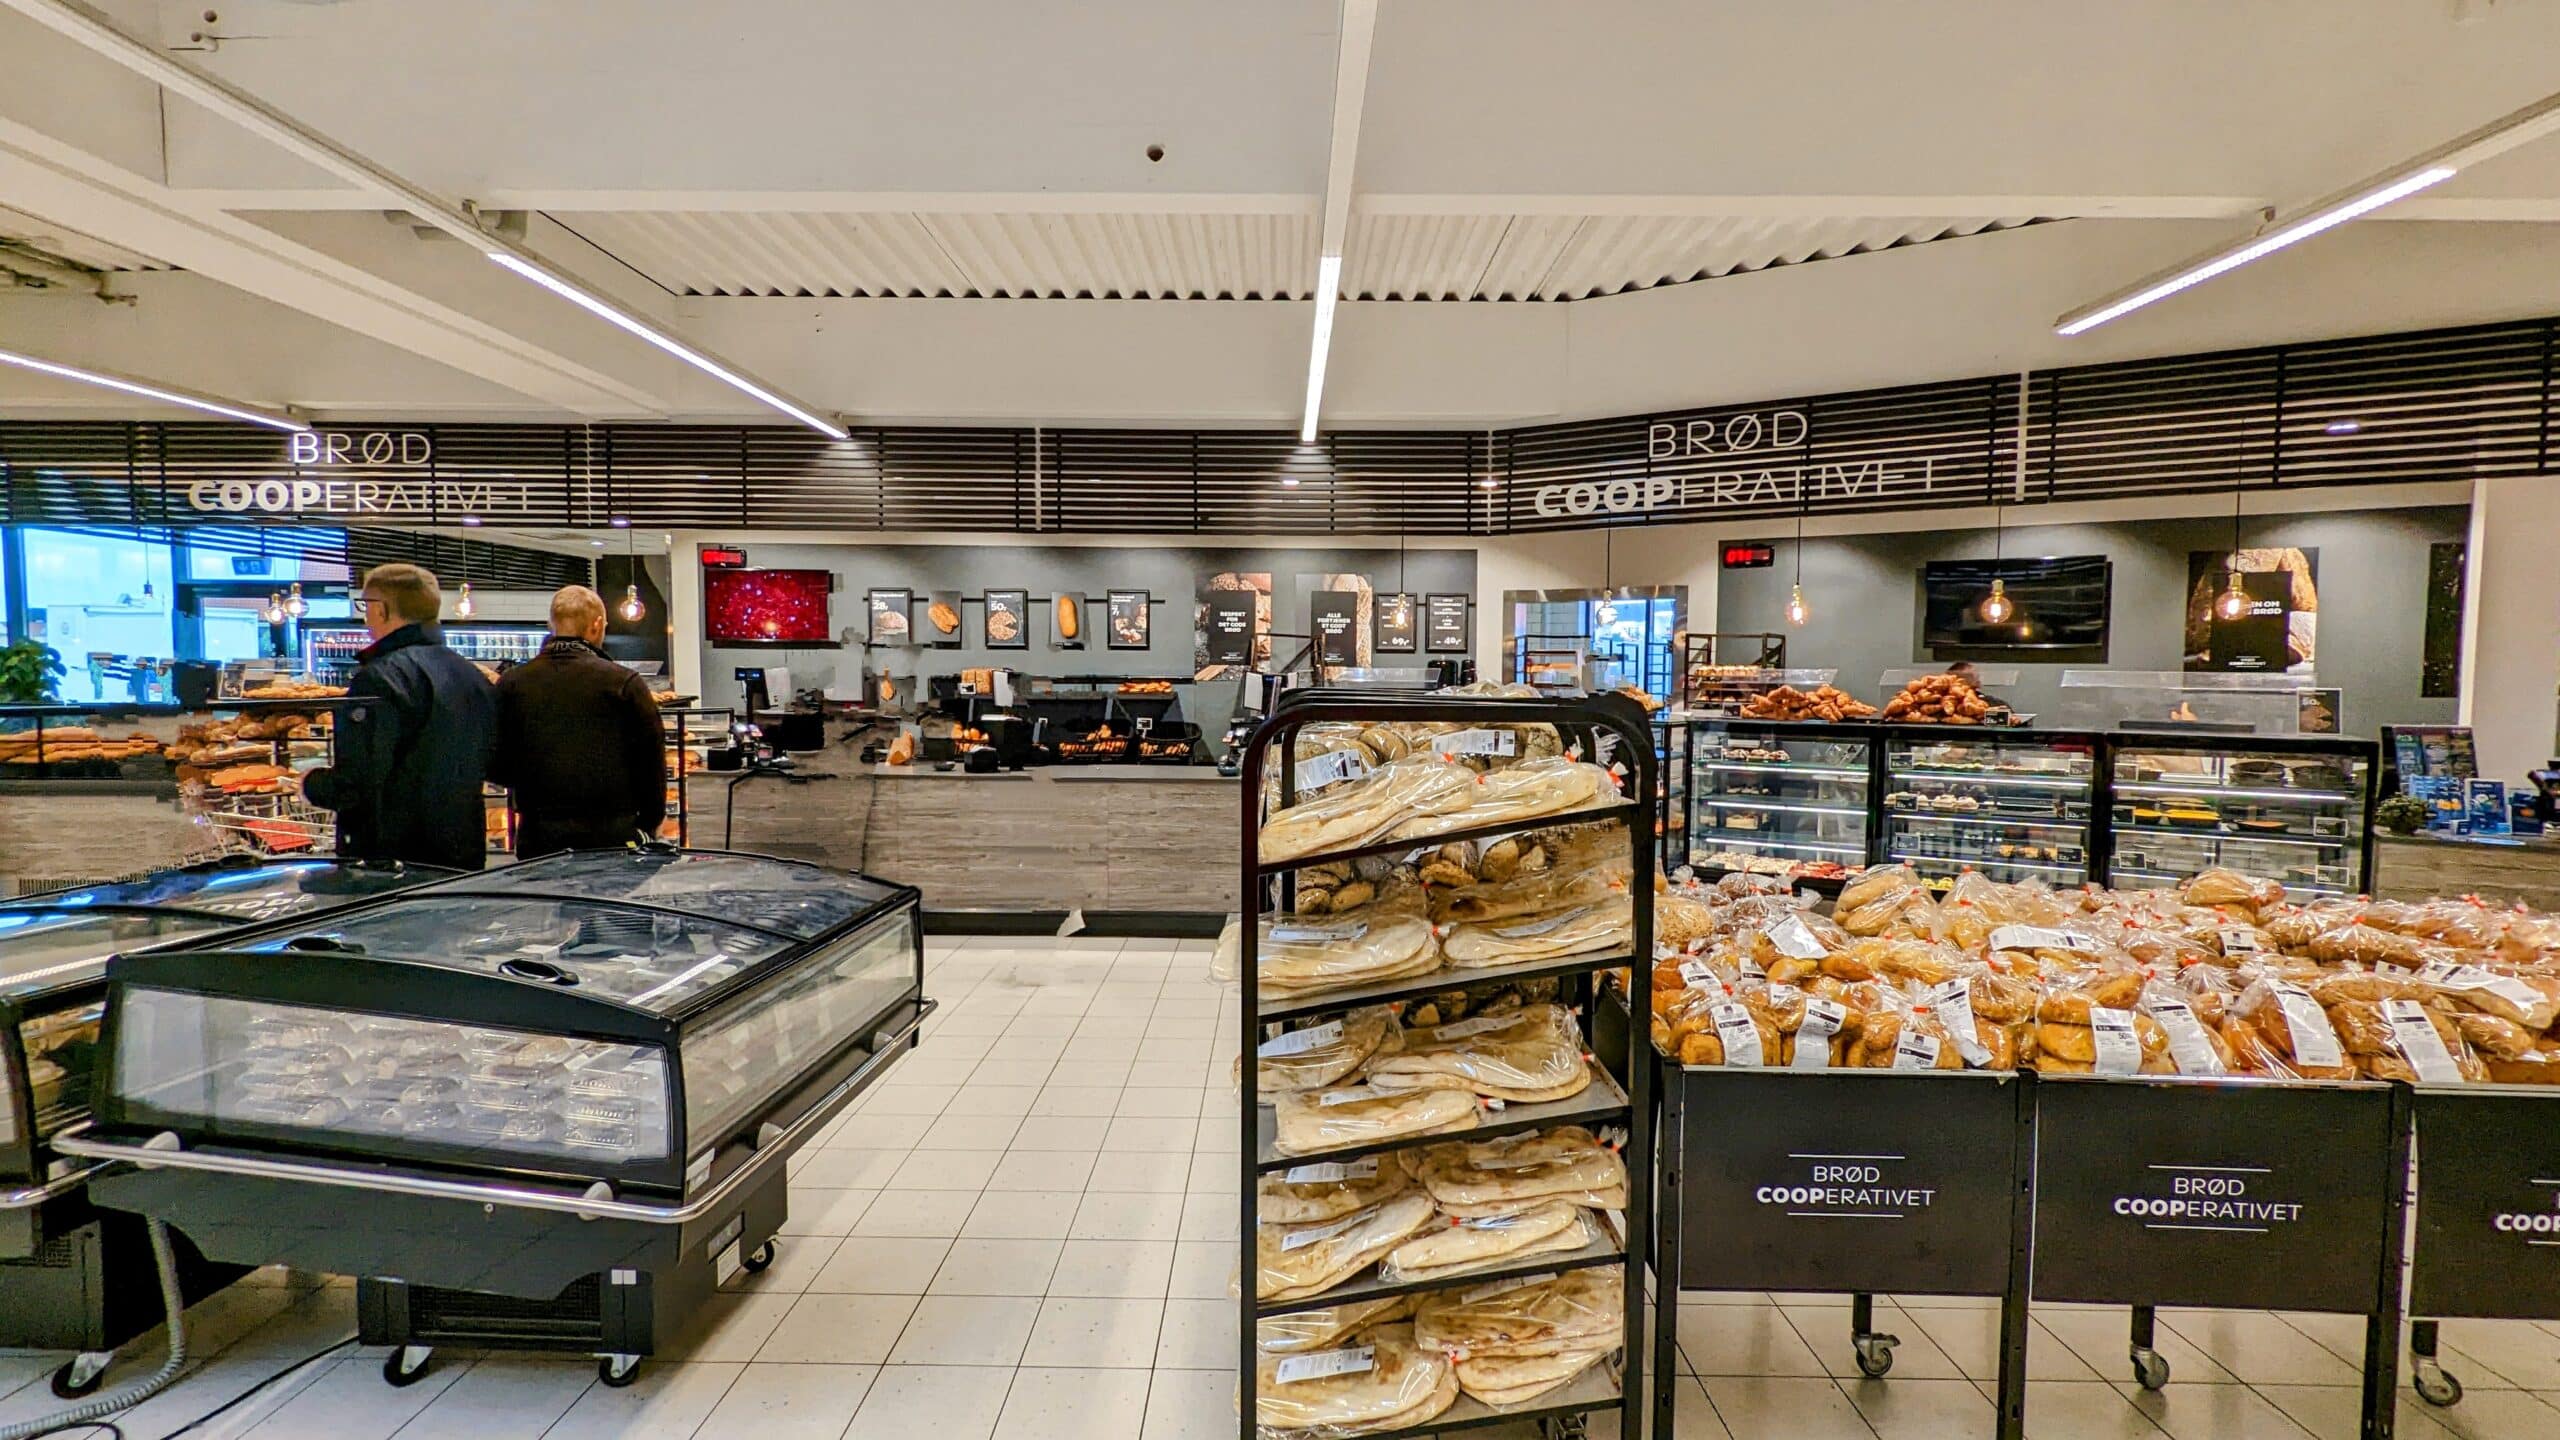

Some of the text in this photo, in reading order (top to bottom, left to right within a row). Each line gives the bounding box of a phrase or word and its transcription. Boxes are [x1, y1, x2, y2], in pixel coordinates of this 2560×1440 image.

[293, 432, 432, 464] BRØD
[1648, 411, 1808, 458] BRØD
[188, 480, 531, 512] COOPERATIVET
[1534, 458, 1933, 517] COOPERATIVET
[1813, 1166, 1880, 1183] BRØD
[2174, 1177, 2245, 1195] BRØD
[1757, 1187, 1936, 1206] COOPERATIVET
[2114, 1198, 2303, 1221] COOPERATIVET
